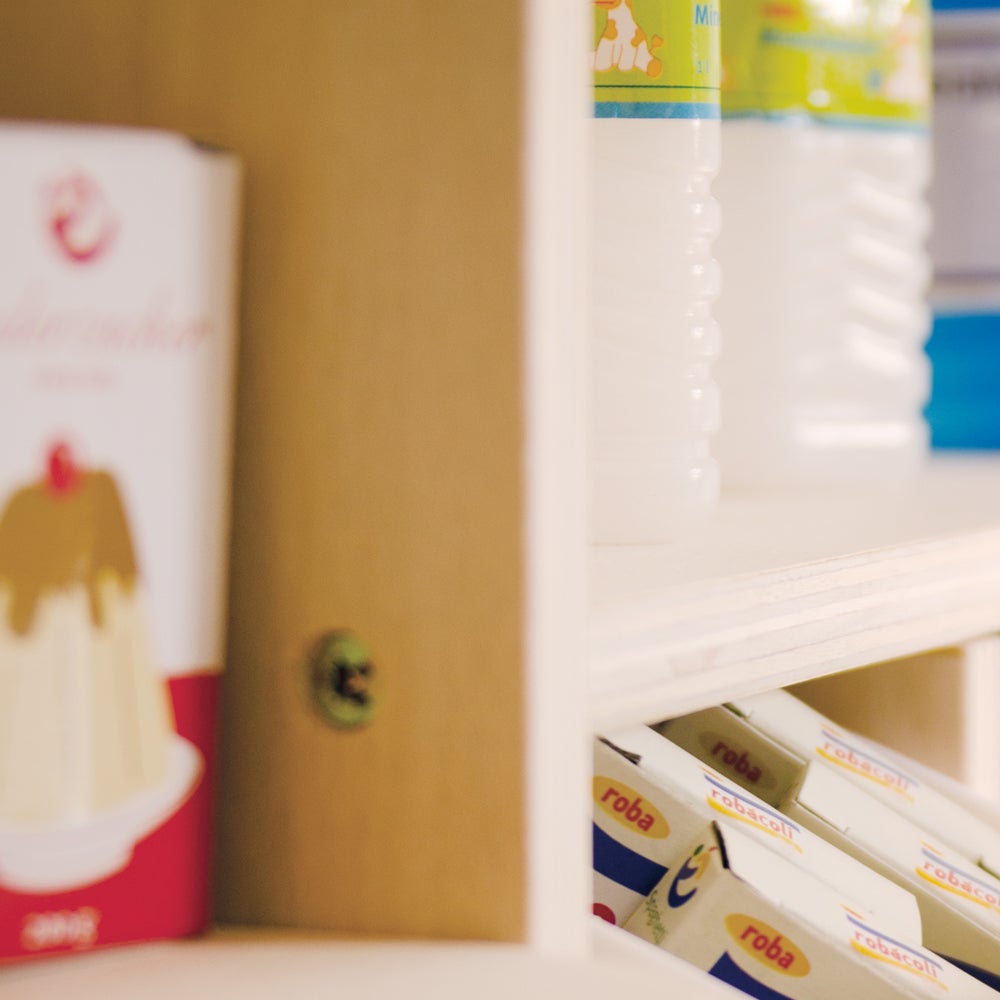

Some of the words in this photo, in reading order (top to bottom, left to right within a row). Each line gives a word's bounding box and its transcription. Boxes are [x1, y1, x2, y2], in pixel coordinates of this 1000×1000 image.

[709, 740, 763, 785] roba
[601, 786, 656, 833] roba
[739, 924, 796, 970] roba
